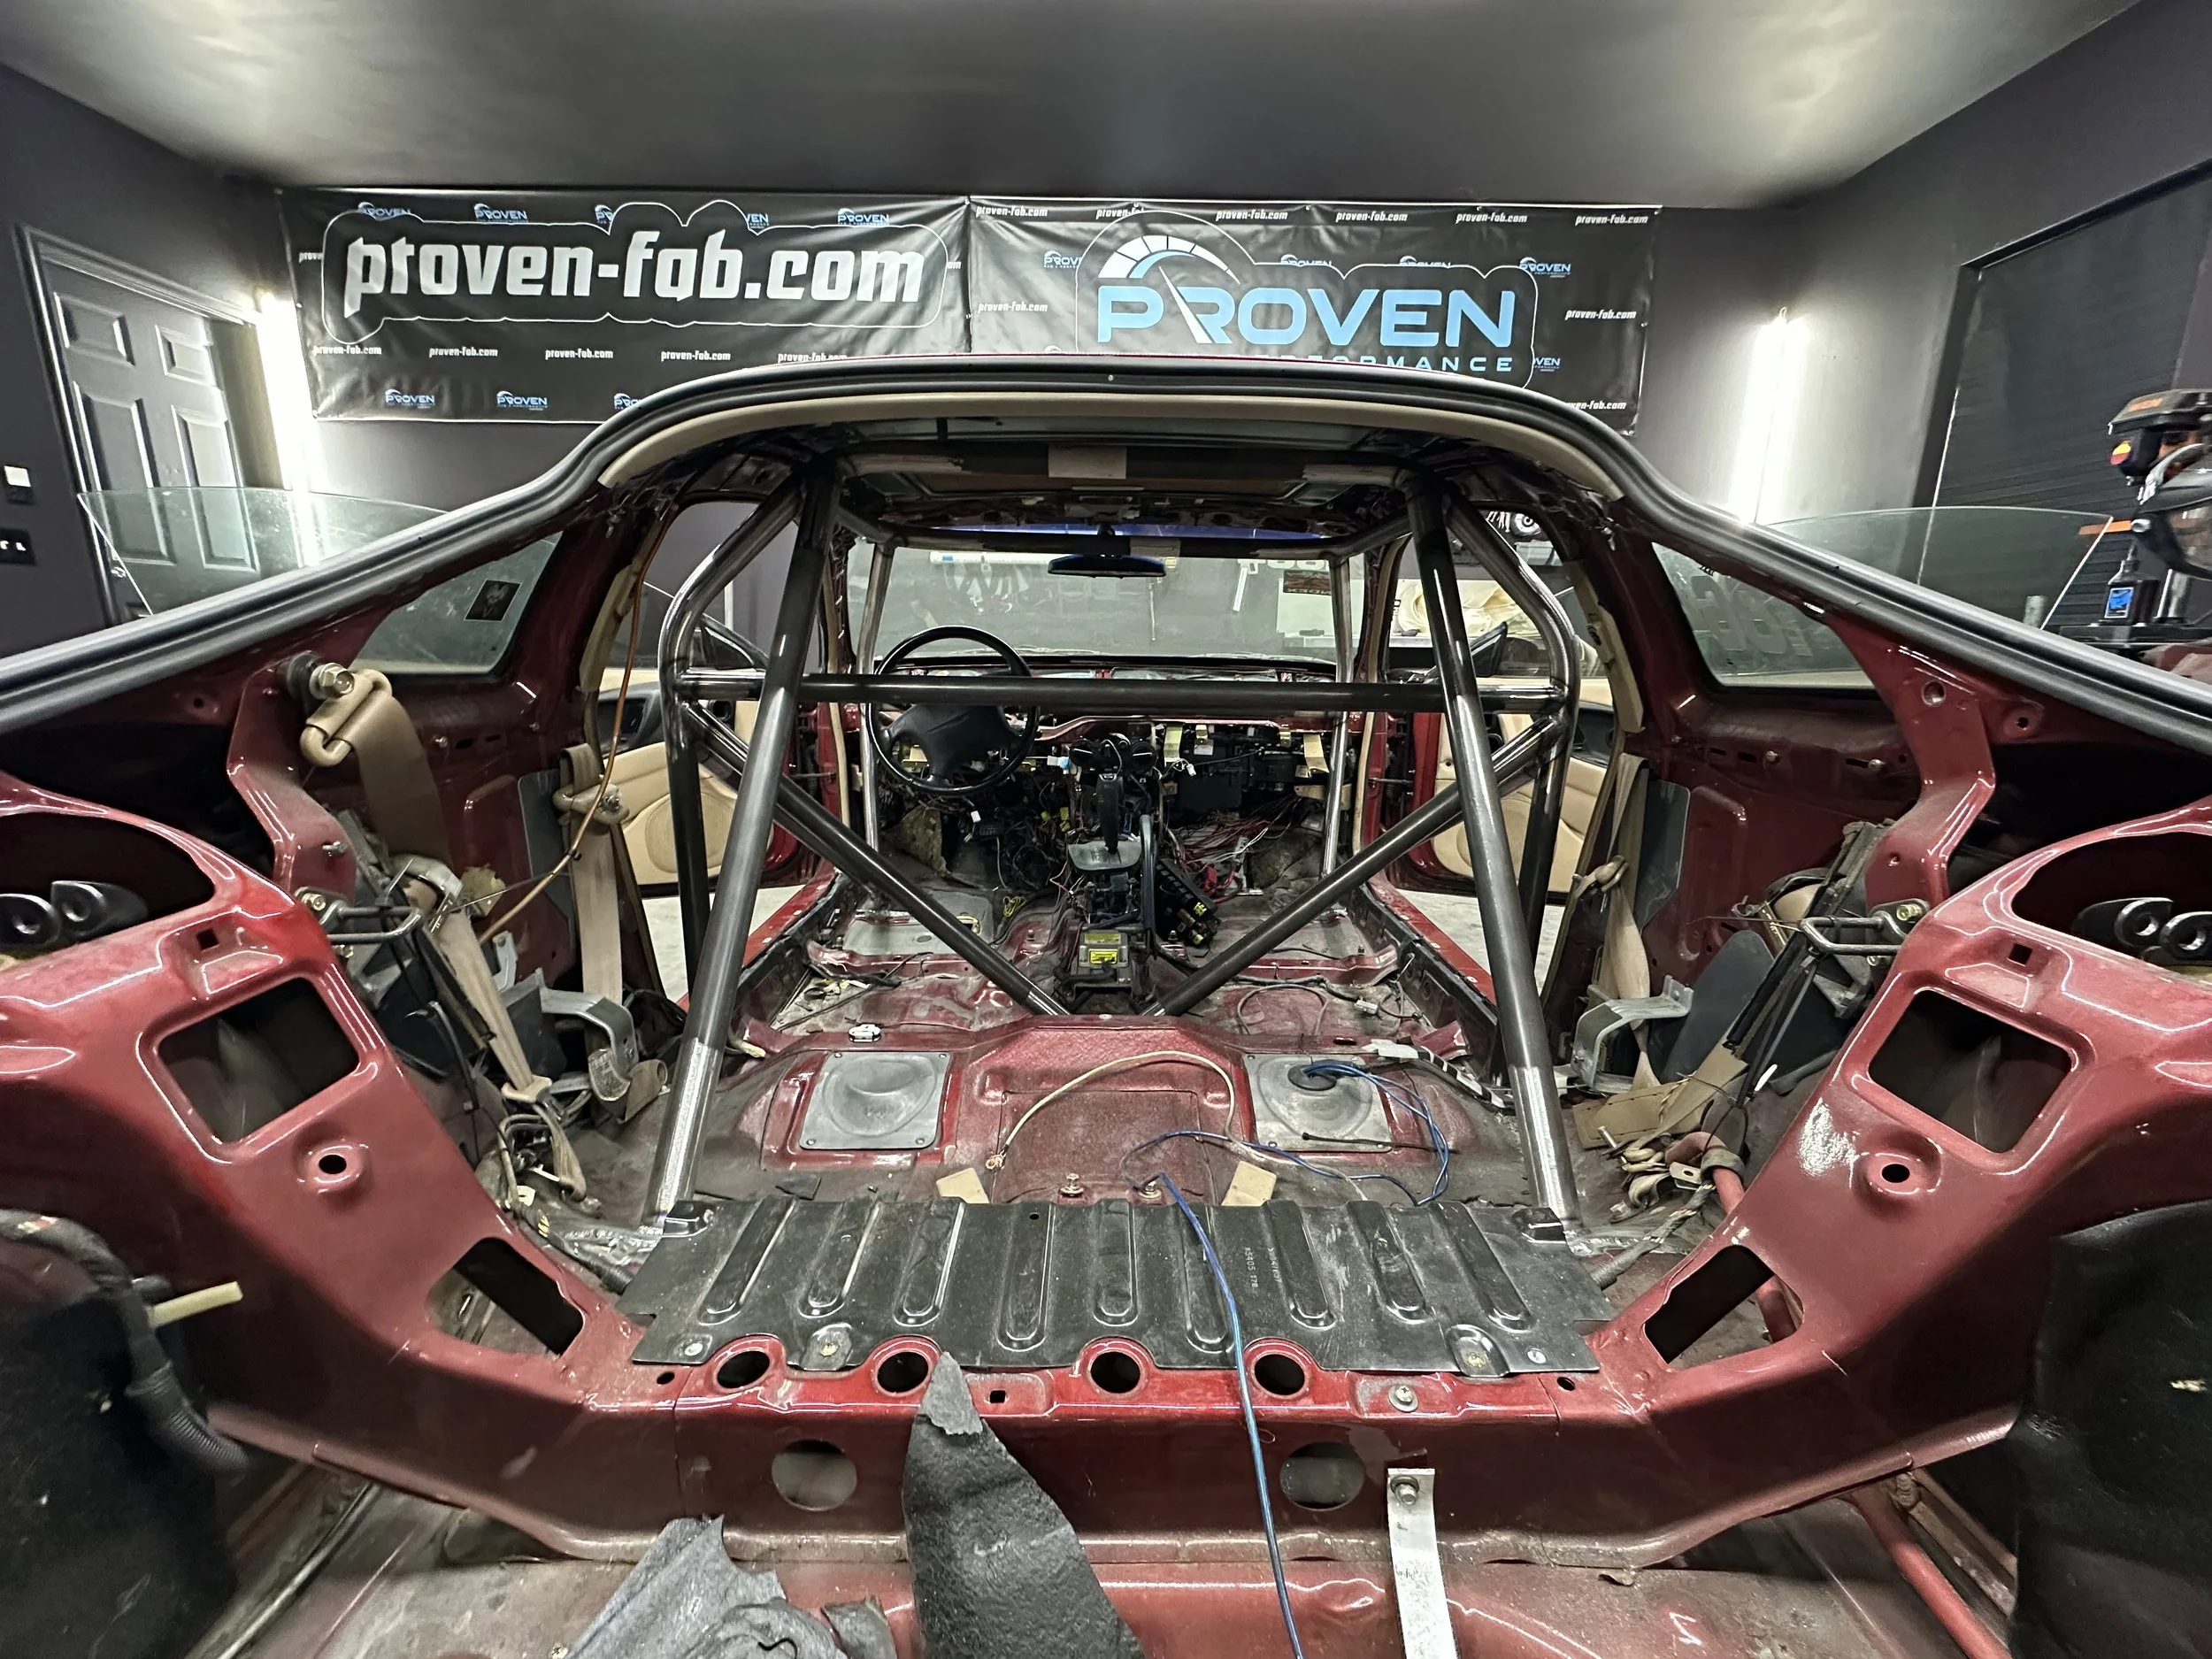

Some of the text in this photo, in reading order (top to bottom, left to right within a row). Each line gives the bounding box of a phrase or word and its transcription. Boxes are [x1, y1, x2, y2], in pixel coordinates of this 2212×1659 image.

[475, 210, 528, 219] PROVEN
[976, 205, 1048, 218] proven-fab.com
[1216, 209, 1288, 221] proven-fab.com
[1335, 211, 1408, 223] proven-fab.com
[1455, 212, 1528, 224] proven-fab.com
[1575, 213, 1648, 226] proven-fab.com
[344, 229, 925, 319] proven-fab.com
[1519, 263, 1571, 273] PROVEN
[978, 302, 1048, 313] proven-fab.com
[1098, 285, 1516, 348] PROVEN
[1564, 310, 1637, 320] proven-fab.com
[428, 347, 498, 358] proven-fab.com
[545, 348, 614, 360] proven-fab.com
[661, 350, 731, 362] proven-fab.com
[385, 395, 435, 404] PROVEN
[497, 396, 548, 405] PROVEN
